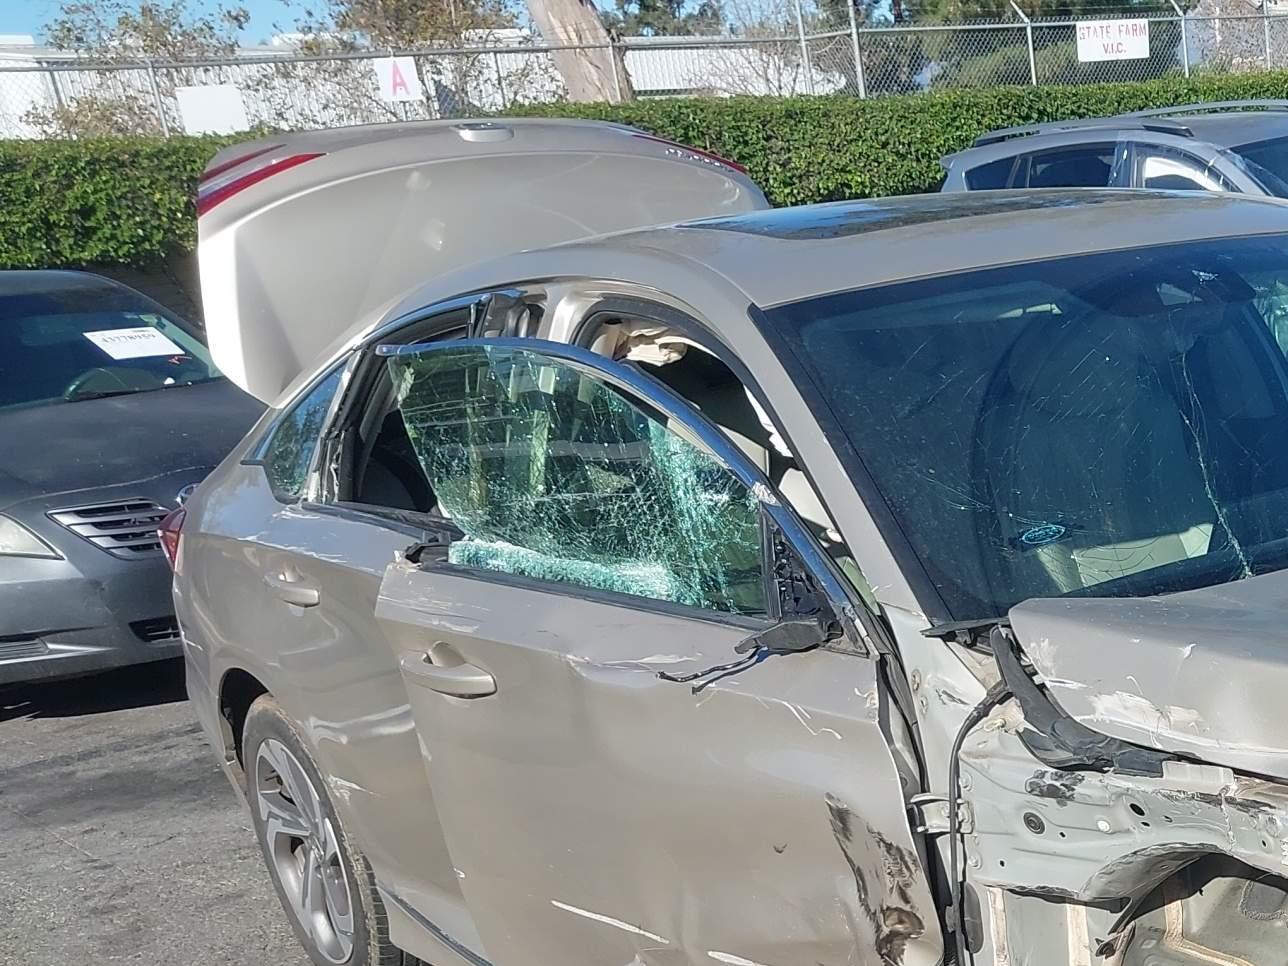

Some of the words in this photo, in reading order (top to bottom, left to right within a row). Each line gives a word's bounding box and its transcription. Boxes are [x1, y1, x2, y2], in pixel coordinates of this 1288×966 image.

[1079, 25, 1111, 40] STATE
[1118, 23, 1147, 38] FARM
[1102, 42, 1127, 54] V.I.C.
[392, 60, 411, 96] A
